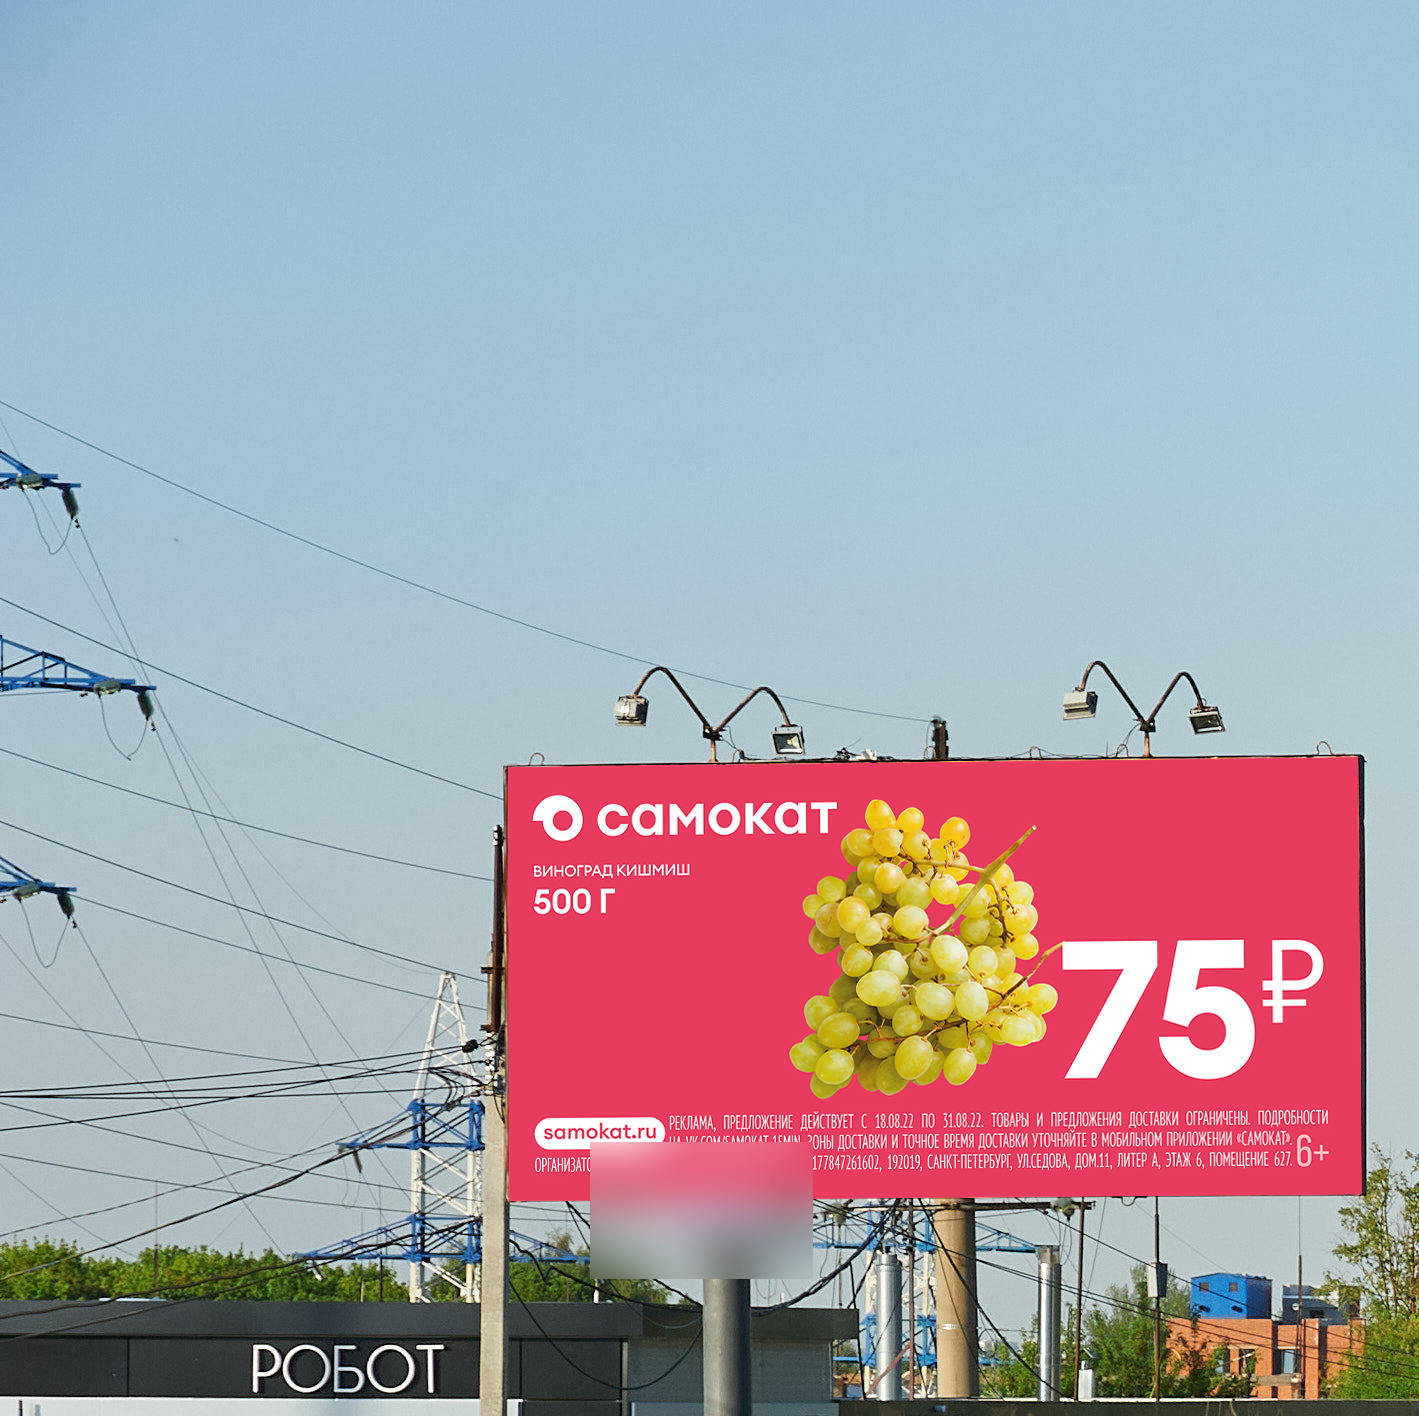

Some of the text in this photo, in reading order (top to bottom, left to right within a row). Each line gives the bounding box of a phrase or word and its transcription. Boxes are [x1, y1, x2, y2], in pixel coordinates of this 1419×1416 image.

[597, 800, 838, 837] самокат
[533, 863, 691, 879] ВИНОГРАД КИШМИШ
[533, 887, 616, 915] 500 Г
[543, 1122, 656, 1142] samokat.ru
[670, 1110, 1329, 1132] РЕКЛАМА, ПРЕДЛОЖЕНИЕ ДЕЙСТВУЕТ С 18.08.22 ПО 31.08.22. ТОВАРЫ И ПРЕДЛОЖЕНИЯ ДОСТАВКИ ОГРАНИЧЕНЫ. ПОДРОБНОСТИ
[838, 1134, 888, 1151] ДОСТАВКИ
[903, 1134, 939, 1149] ТОЧНОЕ
[944, 1133, 974, 1148] ВРЕМЯ
[978, 1133, 1028, 1150] ДОСТАВКИ
[1032, 1130, 1087, 1148] УТОЧНЯЙТЕ
[1102, 1132, 1163, 1147] МОБИЛЬНОМ
[1167, 1131, 1233, 1148] ПРИЛОЖЕНИИ
[1237, 1130, 1293, 1146] «САМОКАТ».
[1296, 1133, 1330, 1168] 6+
[888, 1154, 923, 1171] 192019,
[928, 1154, 1012, 1170] САНКТ-ПЕТЕРБУРГ,
[1017, 1153, 1070, 1170] УЛ.СЕДОВА,
[1117, 1153, 1147, 1167] ЛИТЕР
[1166, 1152, 1191, 1167] ЭТАЖ
[1209, 1152, 1269, 1169] ПОМЕЩЕНИЕ
[1275, 1151, 1293, 1166] 627.
[252, 1344, 445, 1394] РОБОТ
